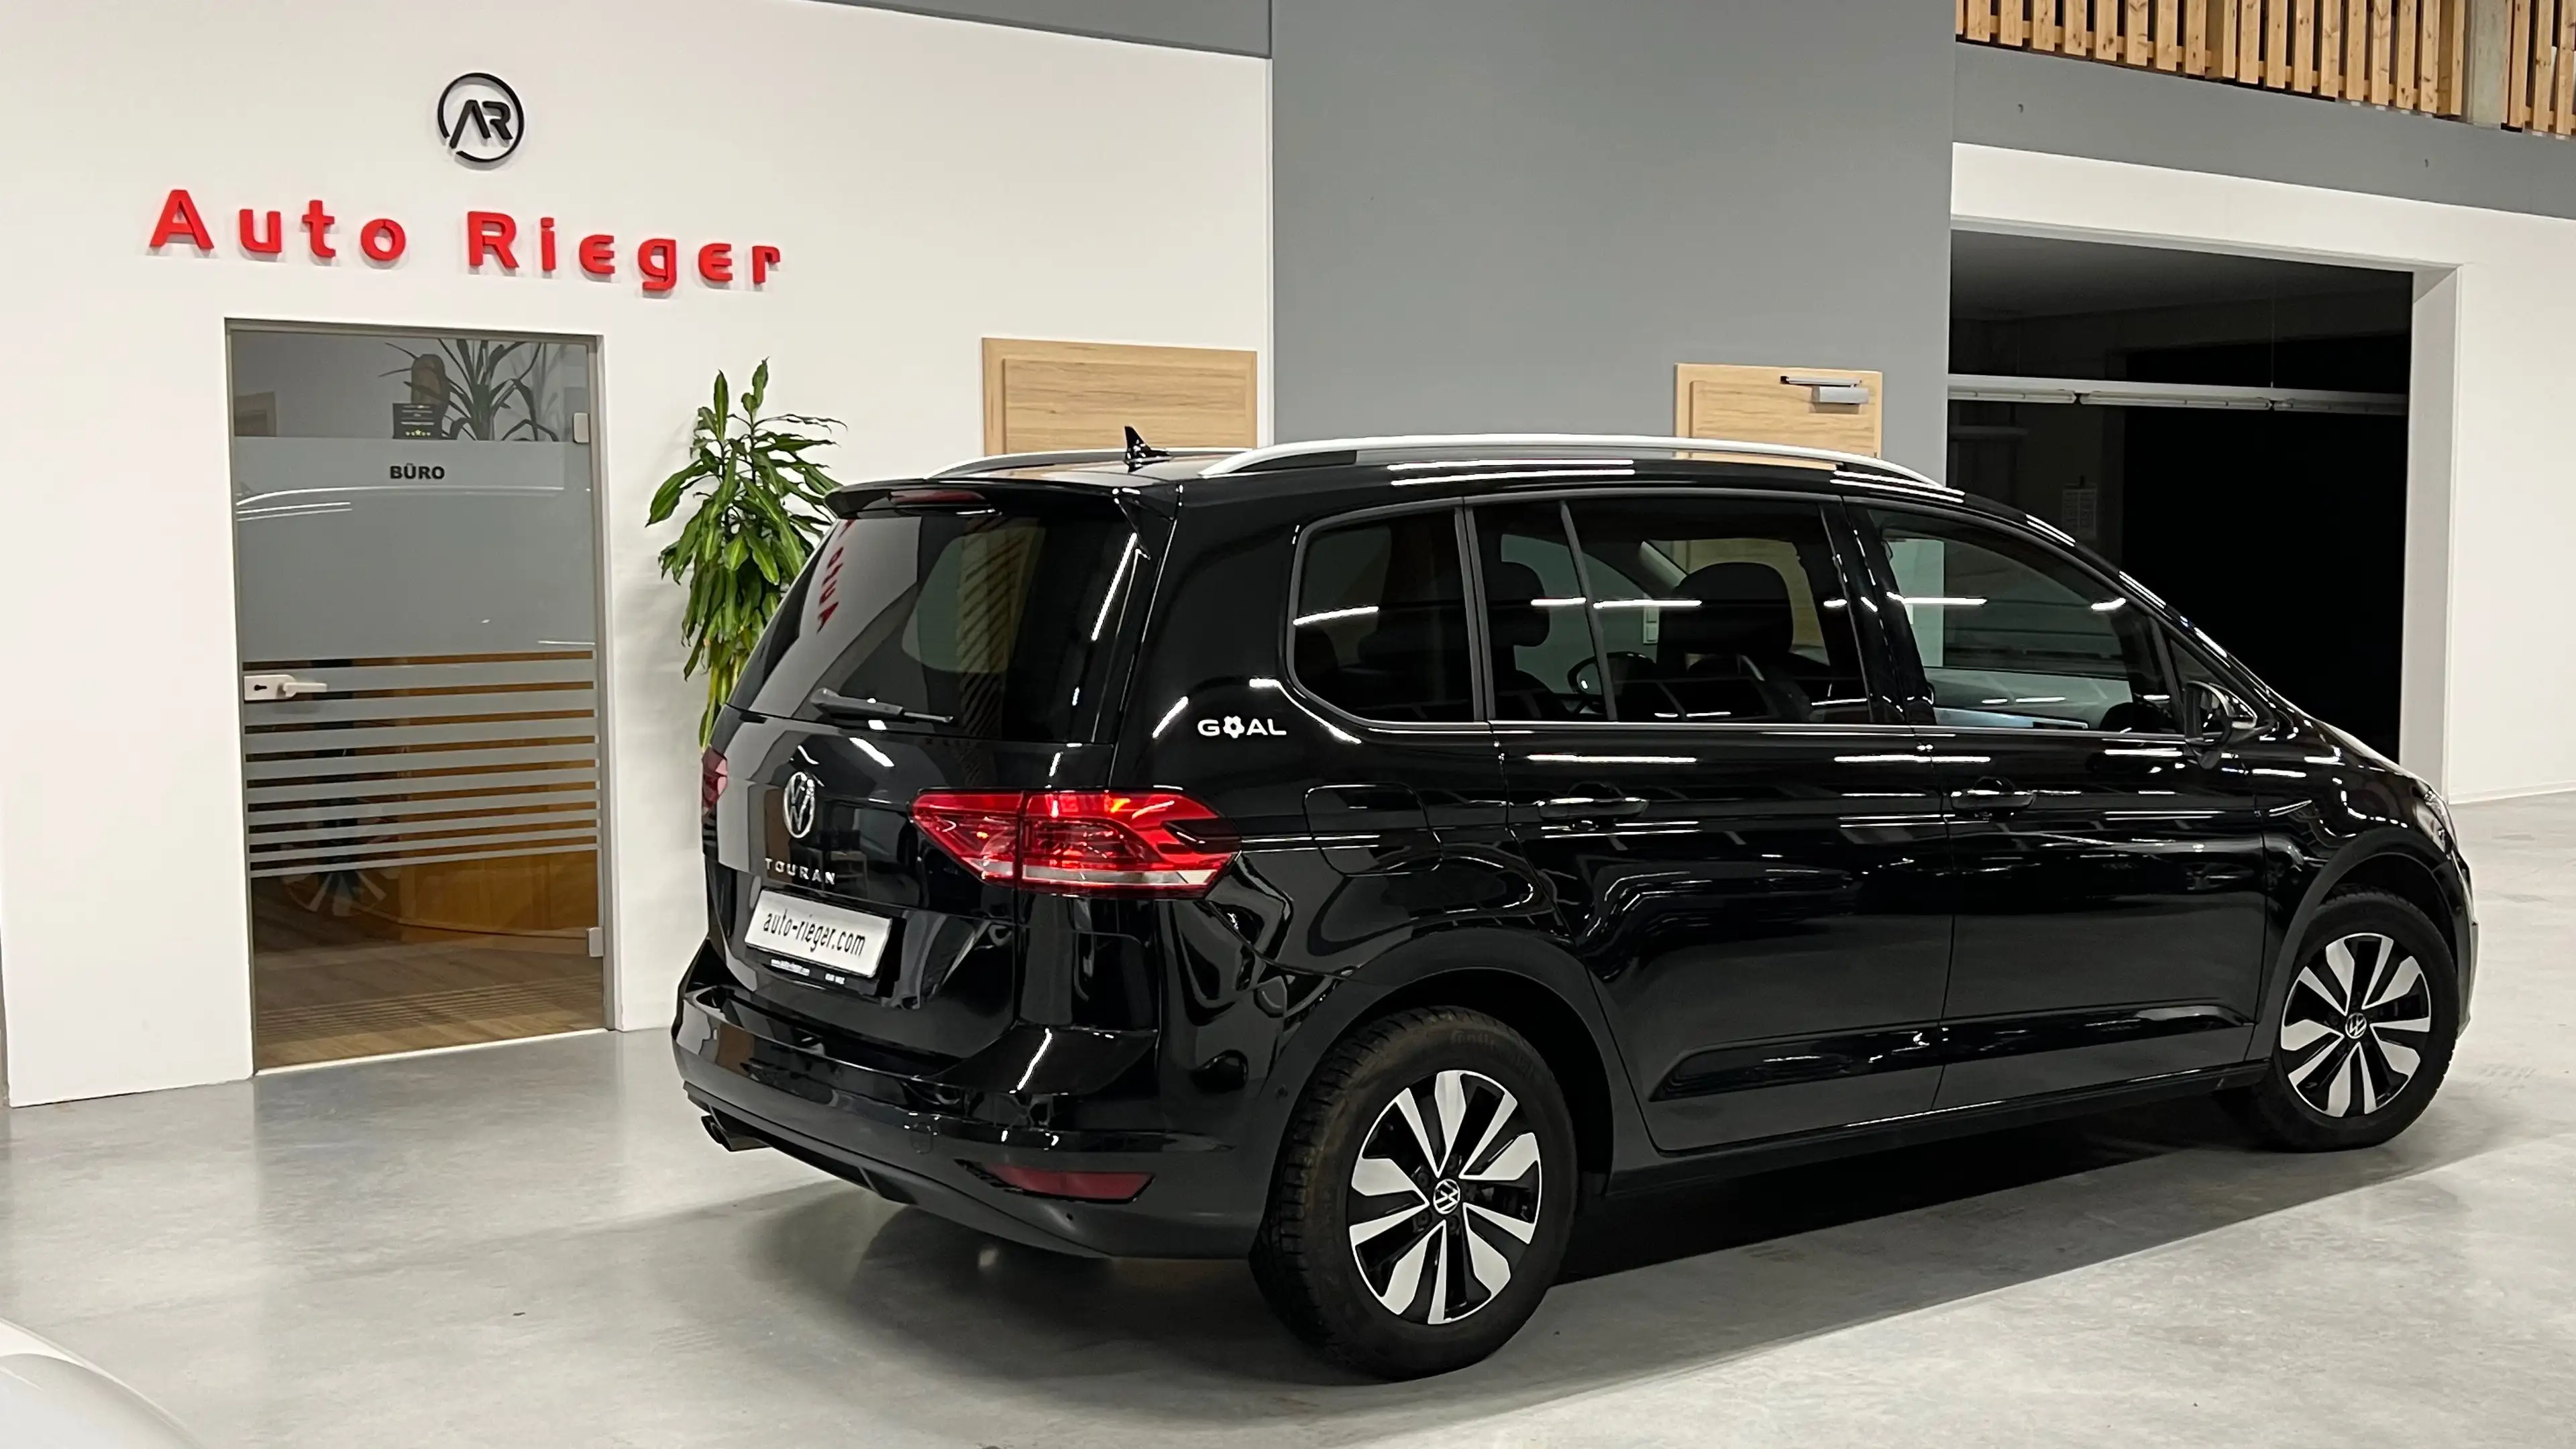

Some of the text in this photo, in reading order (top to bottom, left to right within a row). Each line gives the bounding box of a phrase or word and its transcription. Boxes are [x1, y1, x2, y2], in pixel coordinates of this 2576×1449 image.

[449, 99, 513, 149] AR
[150, 189, 780, 291] Auto Rieger
[390, 463, 445, 480] BÜRO
[1197, 715, 1287, 739] GOAL
[765, 857, 836, 885] TOURAN
[763, 908, 866, 957] auto-rieger.com
